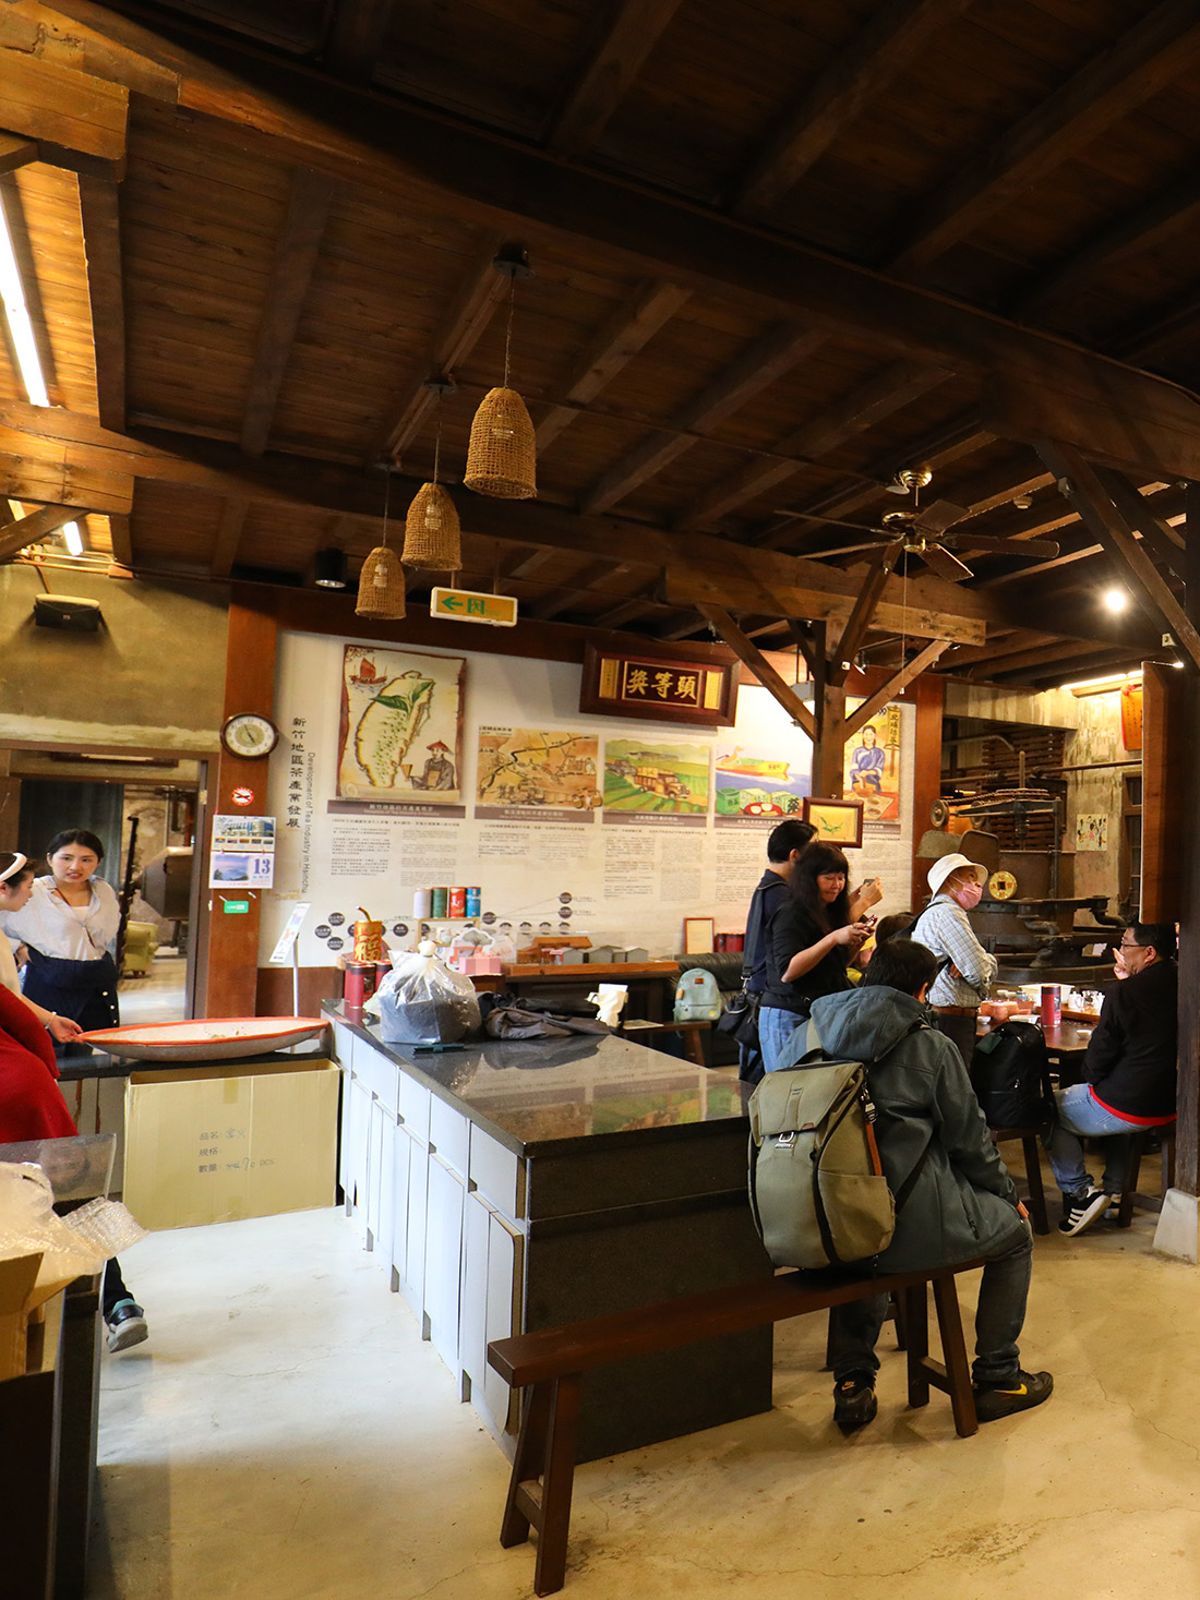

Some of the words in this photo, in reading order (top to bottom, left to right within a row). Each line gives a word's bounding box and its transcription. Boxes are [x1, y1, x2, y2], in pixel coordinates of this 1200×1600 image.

[286, 717, 306, 828] 新竹地區茶產業發展
[305, 752, 316, 800] Development
[304, 810, 313, 823] Tea
[305, 801, 313, 809] of
[302, 825, 312, 854] Industry
[254, 858, 270, 874] 13
[301, 863, 312, 894] Hsinchu
